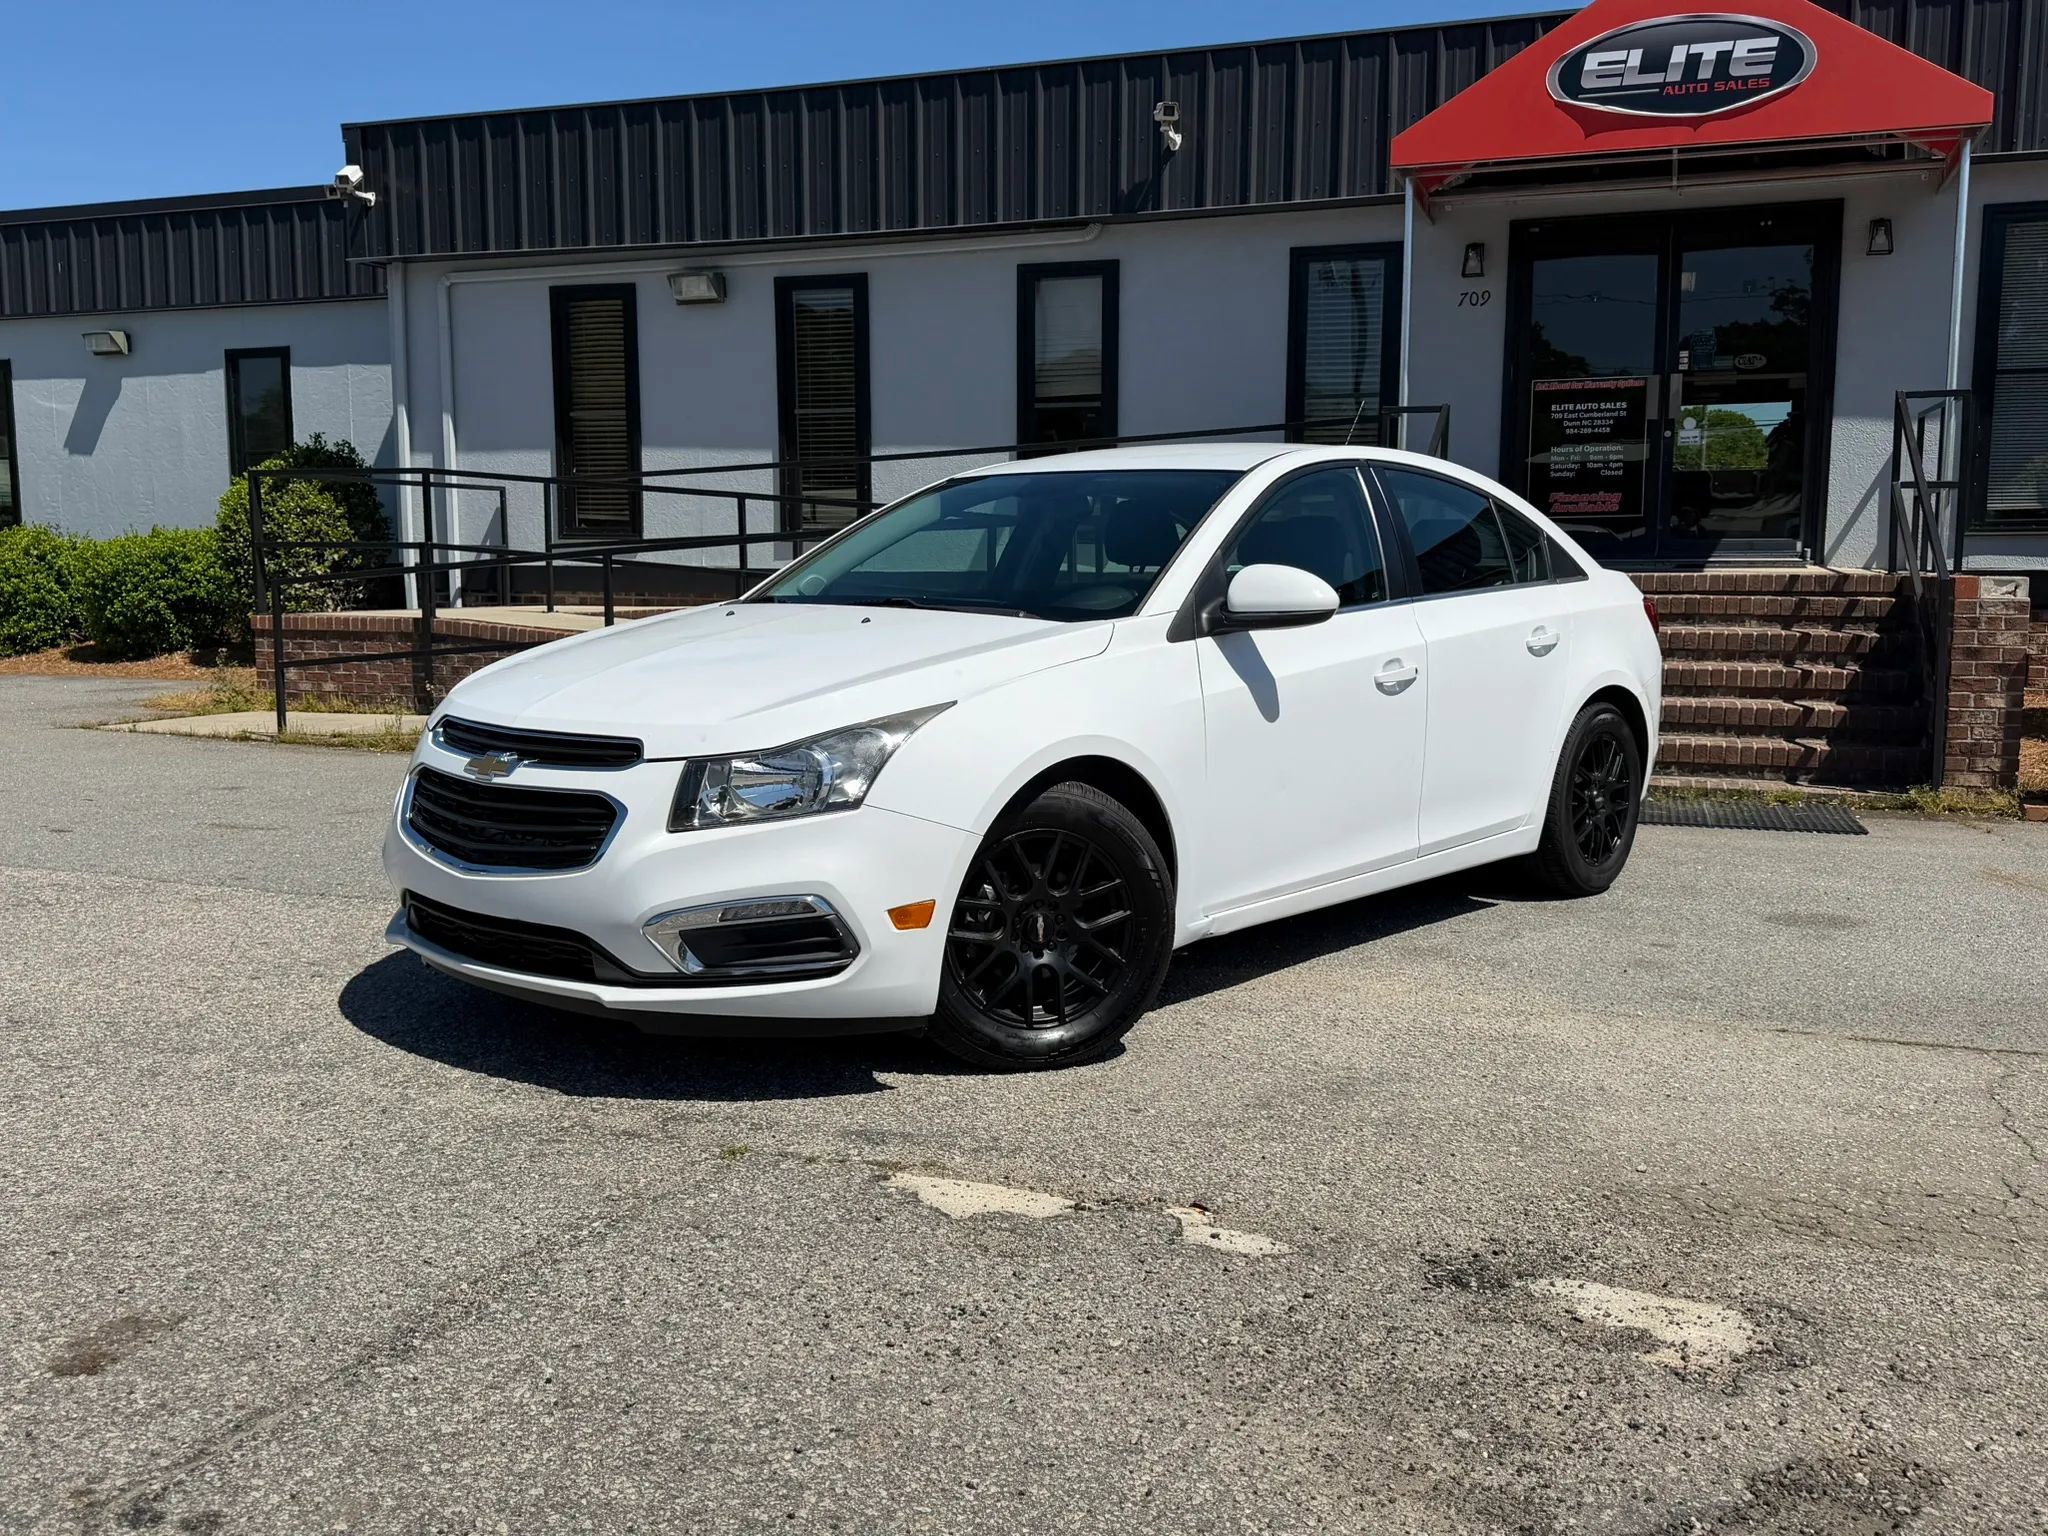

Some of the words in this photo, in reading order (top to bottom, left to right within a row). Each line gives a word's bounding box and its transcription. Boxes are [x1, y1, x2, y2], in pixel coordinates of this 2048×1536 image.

[1579, 36, 1780, 89] ELITE
[1663, 81, 1709, 96] AUTO
[1714, 77, 1771, 93] SALES
[1457, 289, 1491, 308] 709
[1551, 403, 1574, 411] ELITE
[1599, 402, 1627, 410] SALES
[1584, 445, 1624, 454] Operation:
[1550, 471, 1576, 479] Sunday:
[1549, 491, 1622, 504] Financing
[1550, 502, 1620, 513] Available
